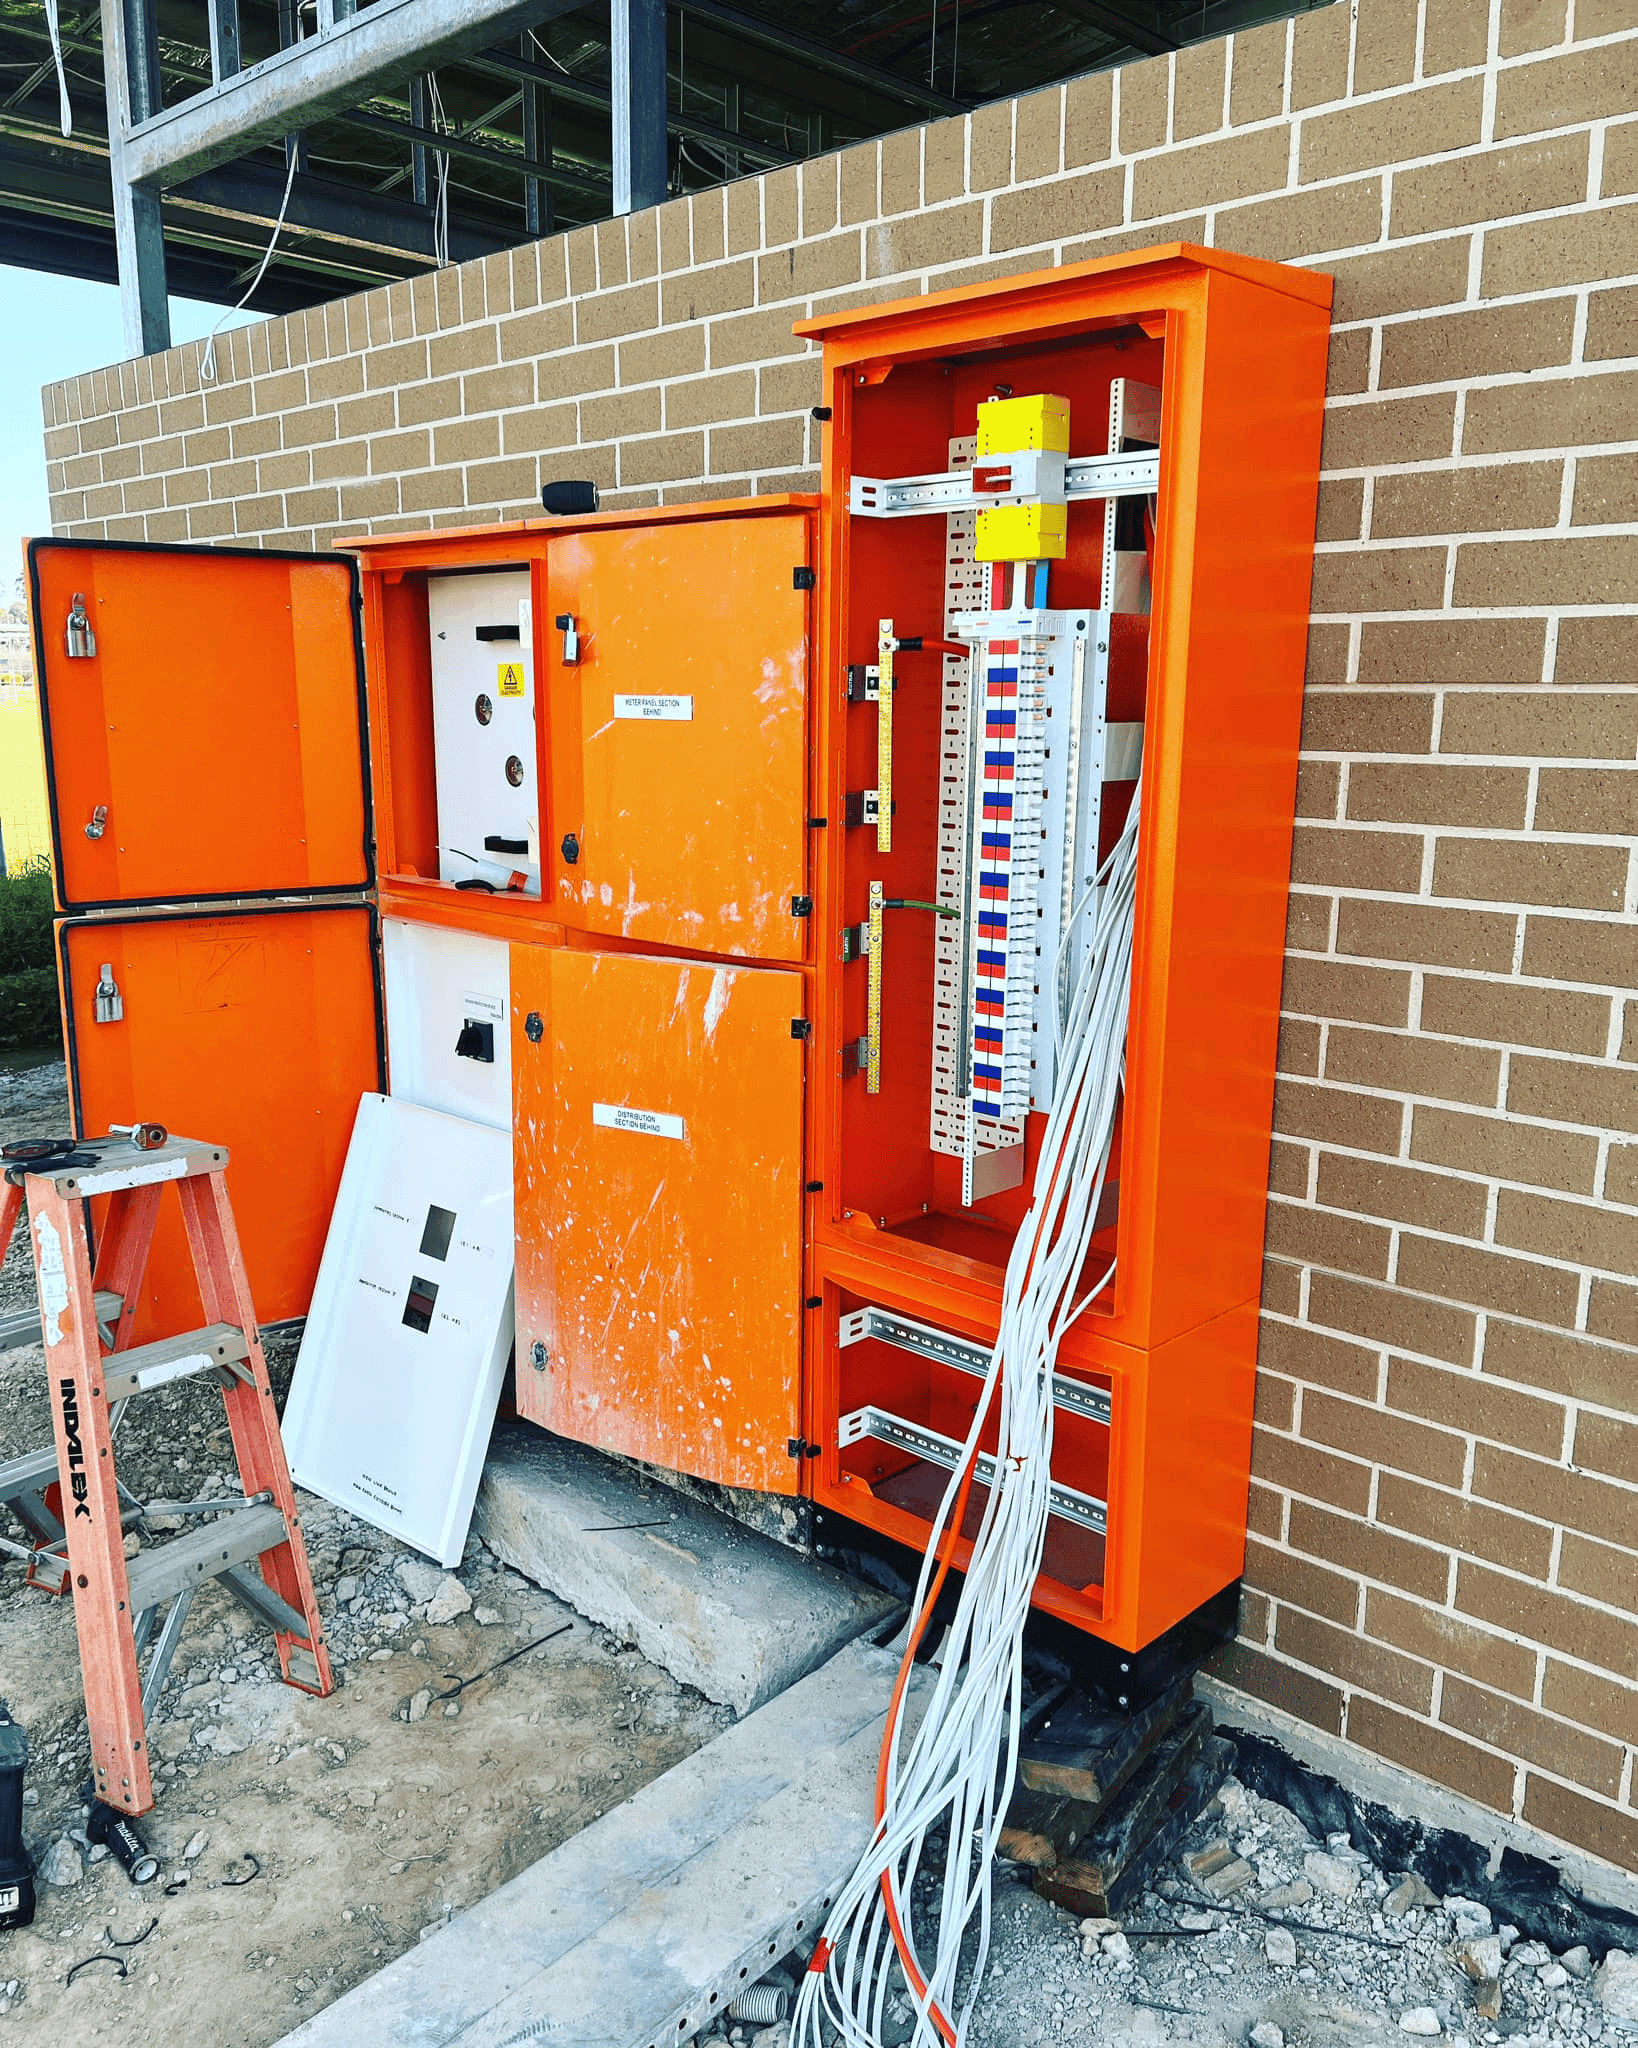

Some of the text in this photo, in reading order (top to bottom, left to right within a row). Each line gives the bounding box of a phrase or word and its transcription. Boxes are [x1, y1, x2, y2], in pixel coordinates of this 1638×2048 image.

[624, 698, 680, 708] METER PANEL SECTION
[642, 707, 662, 716] BEHIND
[617, 1110, 656, 1123] DISTRIBUTION
[614, 1117, 661, 1133] SECTION BEHIND
